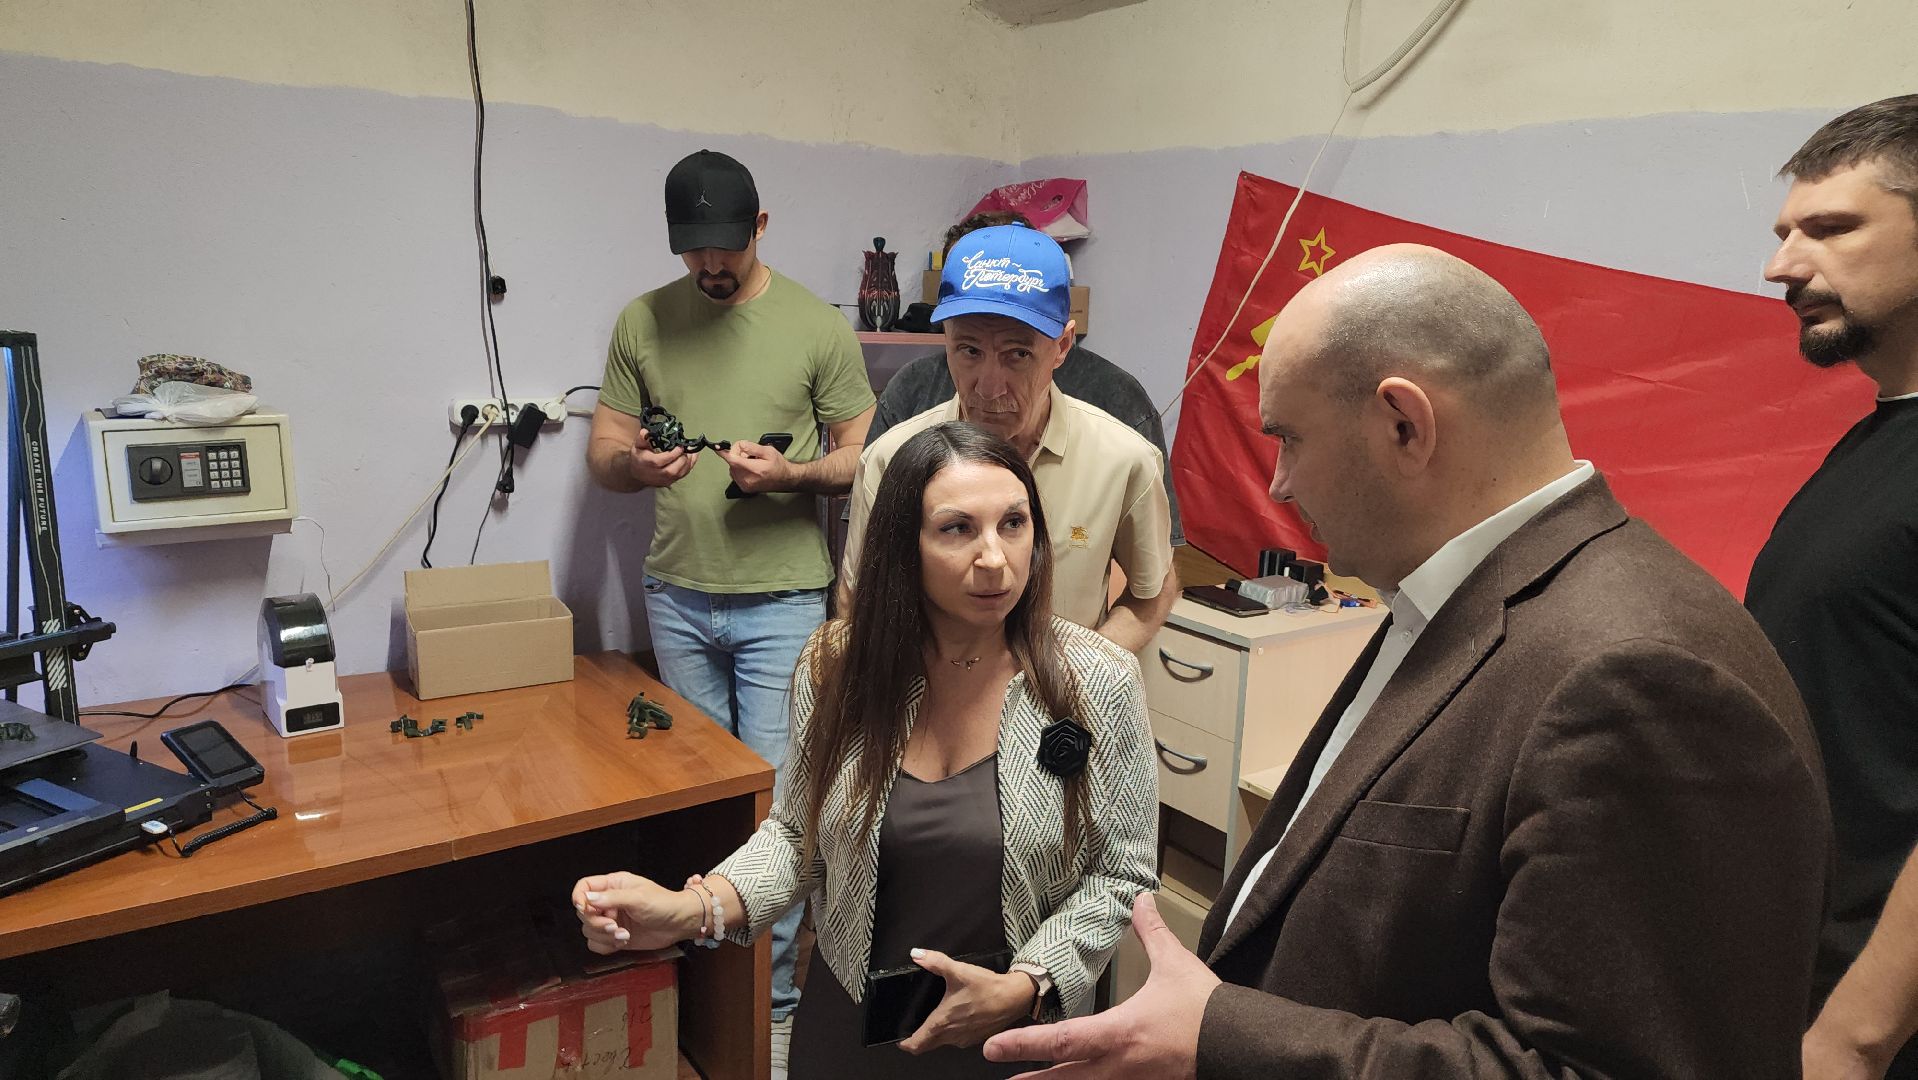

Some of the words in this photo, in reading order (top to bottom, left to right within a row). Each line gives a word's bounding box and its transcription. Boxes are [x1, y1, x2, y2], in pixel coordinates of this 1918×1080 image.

[962, 267, 1050, 293] Петербург
[31, 440, 42, 474] CREATE
[36, 477, 44, 494] THE
[38, 497, 48, 531] FUTURE
